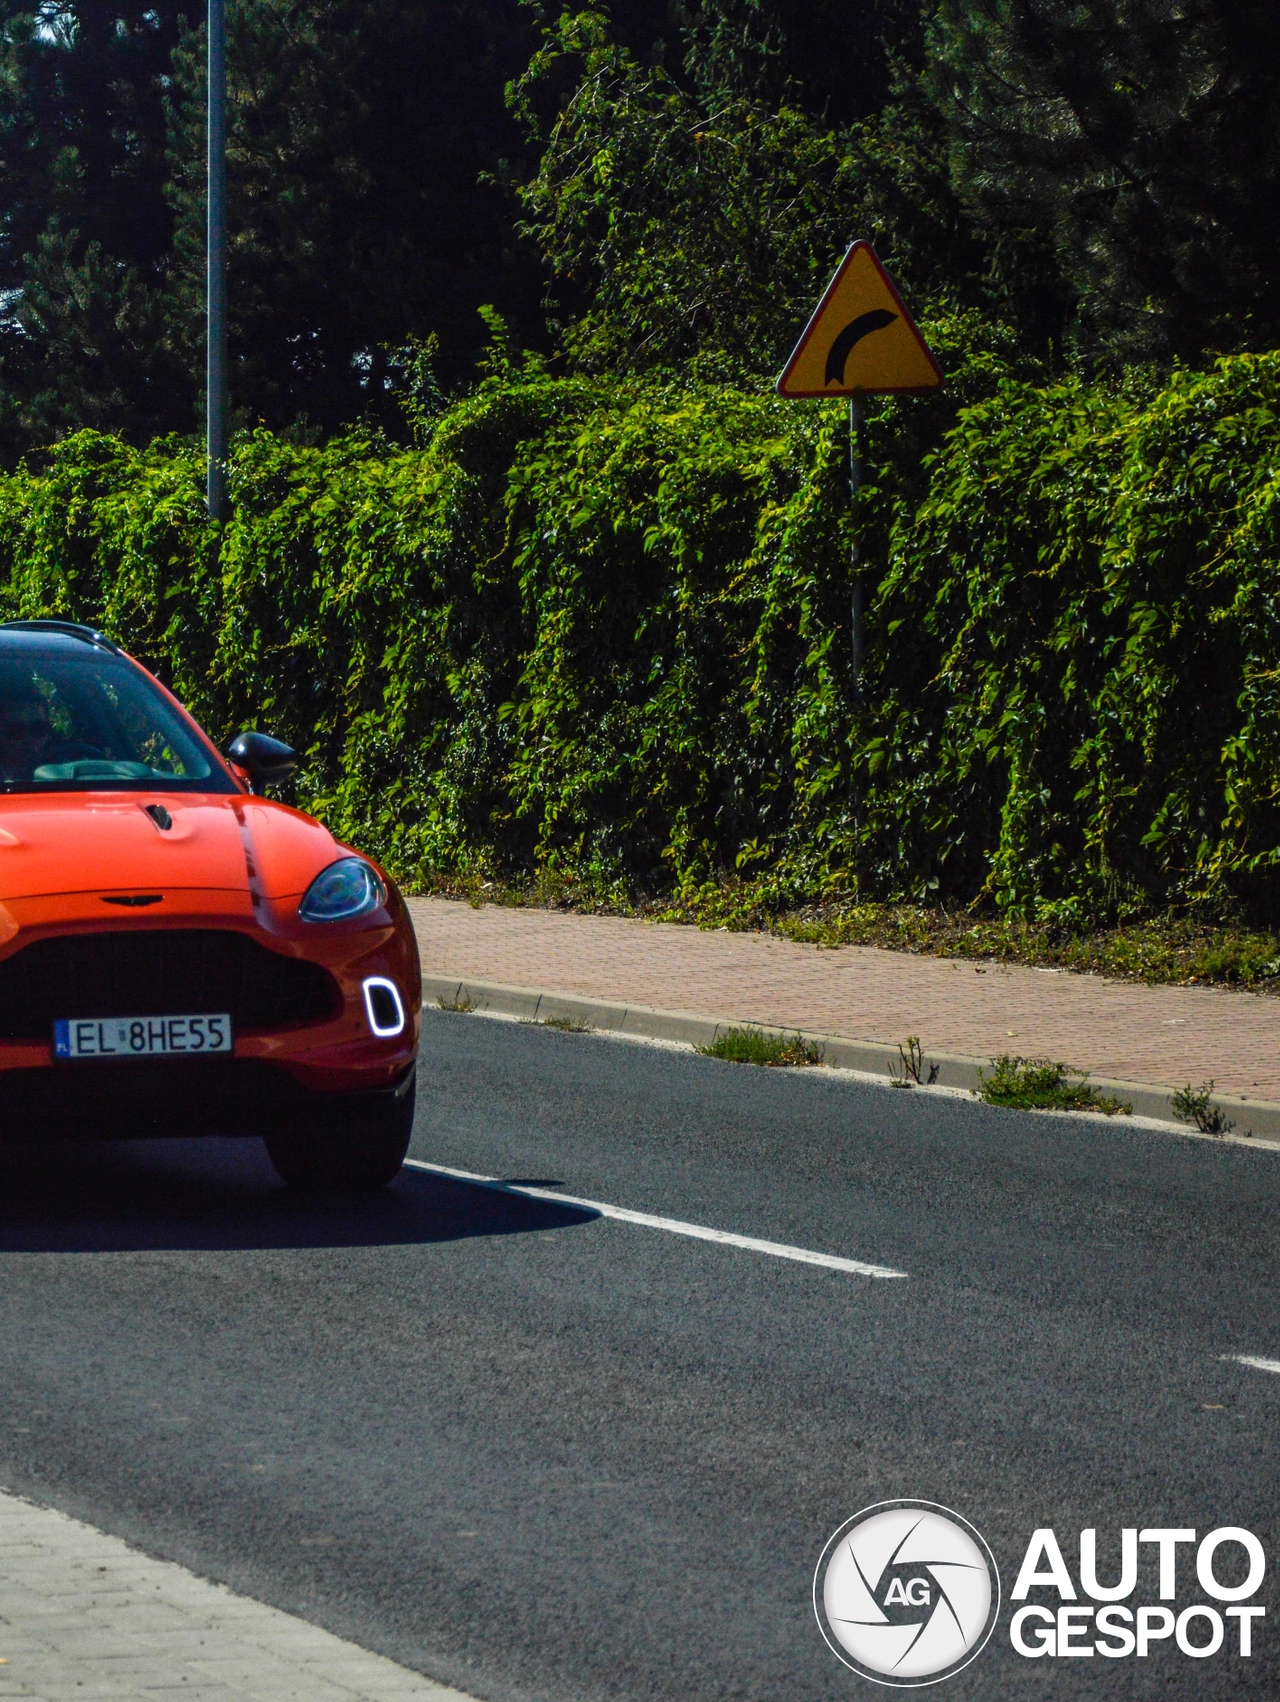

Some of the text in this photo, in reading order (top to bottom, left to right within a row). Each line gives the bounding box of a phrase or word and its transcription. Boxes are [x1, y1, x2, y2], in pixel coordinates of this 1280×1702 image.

[76, 1018, 224, 1054] EL 8HE55
[57, 1043, 68, 1052] PL
